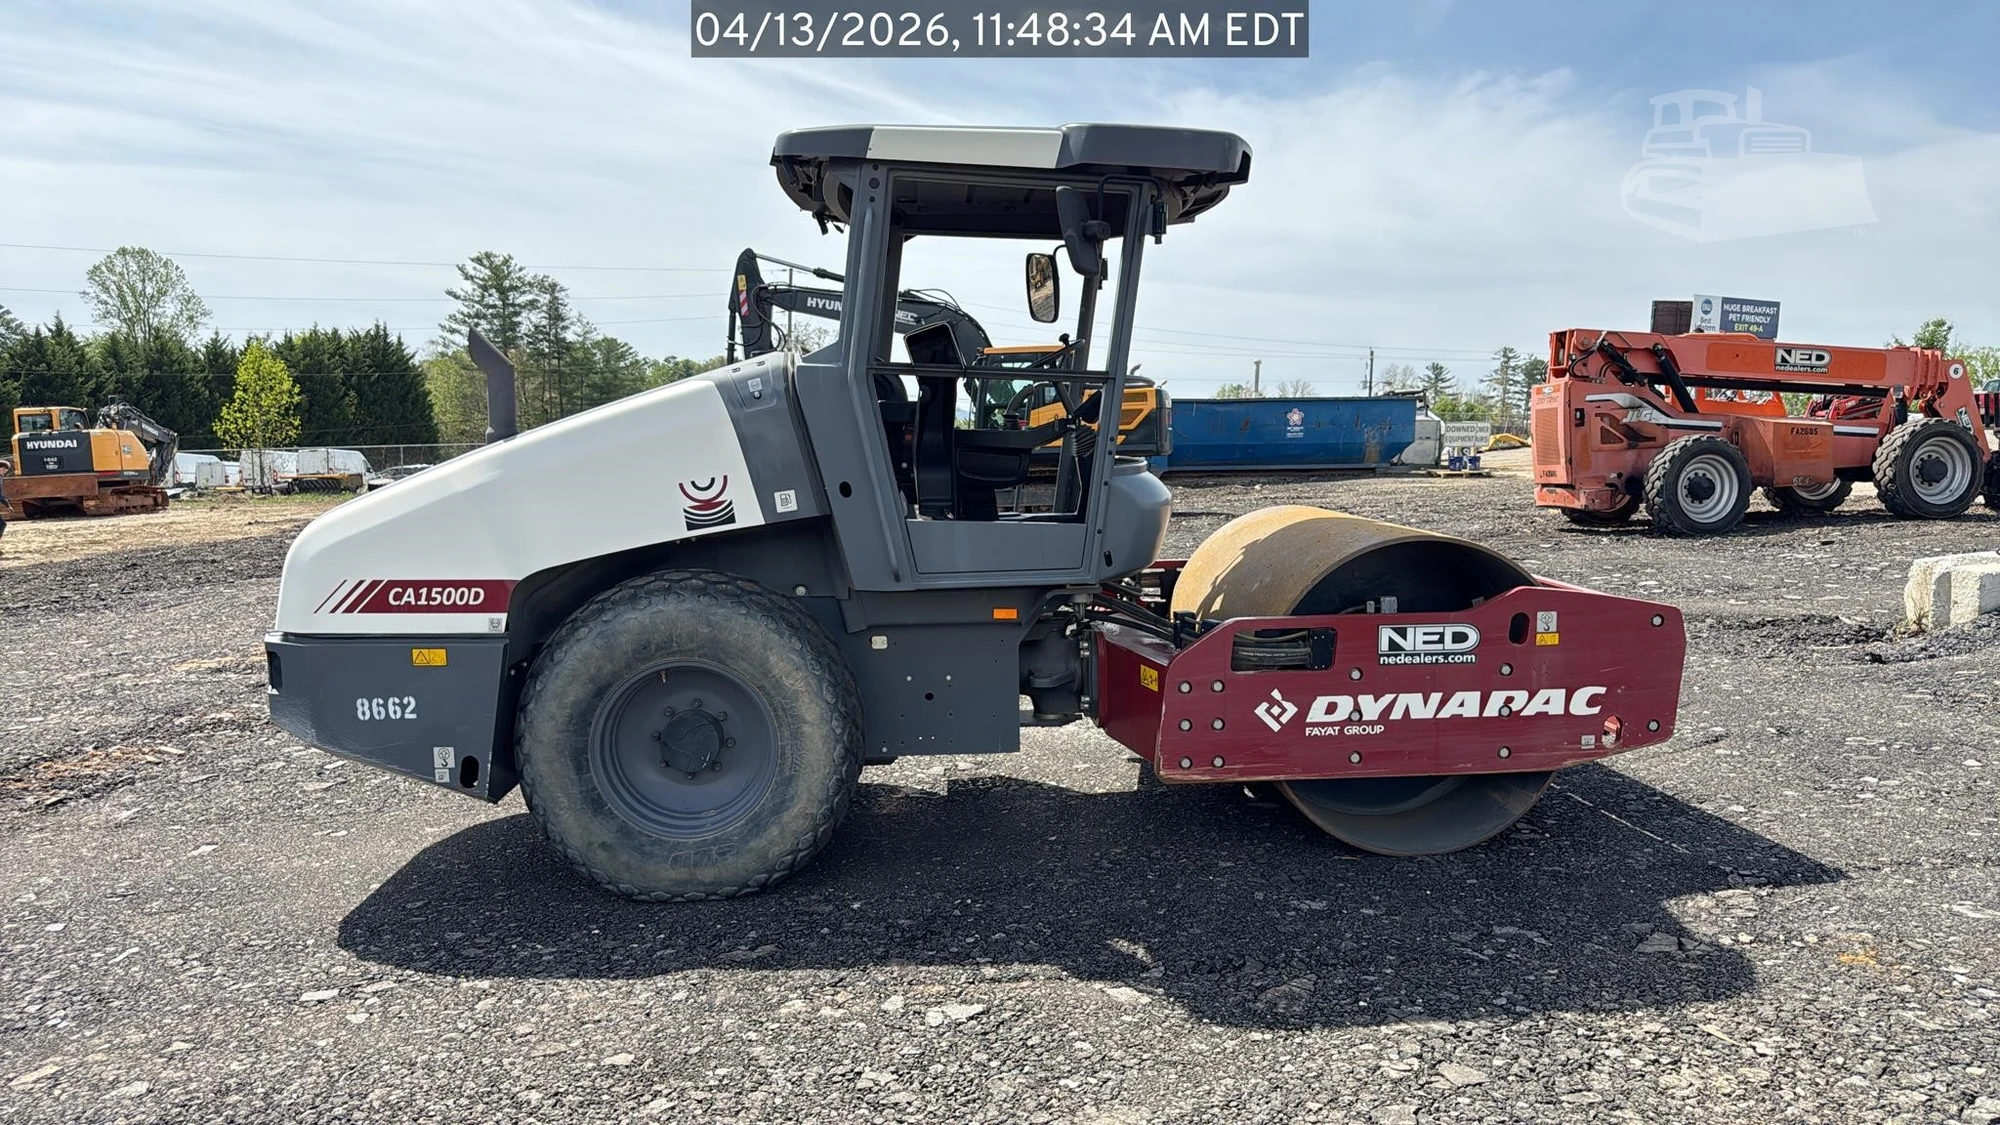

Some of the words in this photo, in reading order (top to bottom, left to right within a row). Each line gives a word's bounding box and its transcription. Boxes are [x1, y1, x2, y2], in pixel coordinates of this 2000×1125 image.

[1723, 303, 1741, 312] HUGE
[1742, 305, 1777, 315] BREAKFAST
[1729, 313, 1740, 321] PET
[1741, 314, 1771, 324] FRIENDLY
[1734, 323, 1748, 331] EXIT
[1749, 324, 1763, 332] 49-A
[1775, 349, 1830, 365] NED
[1775, 365, 1829, 374] nedealers.com
[1446, 425, 1476, 433] DOWNED
[26, 439, 78, 450] HYUNDAI
[1445, 435, 1475, 443] EQUIPMENT
[388, 587, 485, 606] CA1500D
[1380, 625, 1478, 652] NED
[1379, 653, 1476, 664] nedealers.com
[356, 696, 417, 721] 8662
[1305, 686, 1607, 723] DYNAPAC
[1305, 726, 1340, 737] FAYAT
[1344, 725, 1384, 736] GROUP
